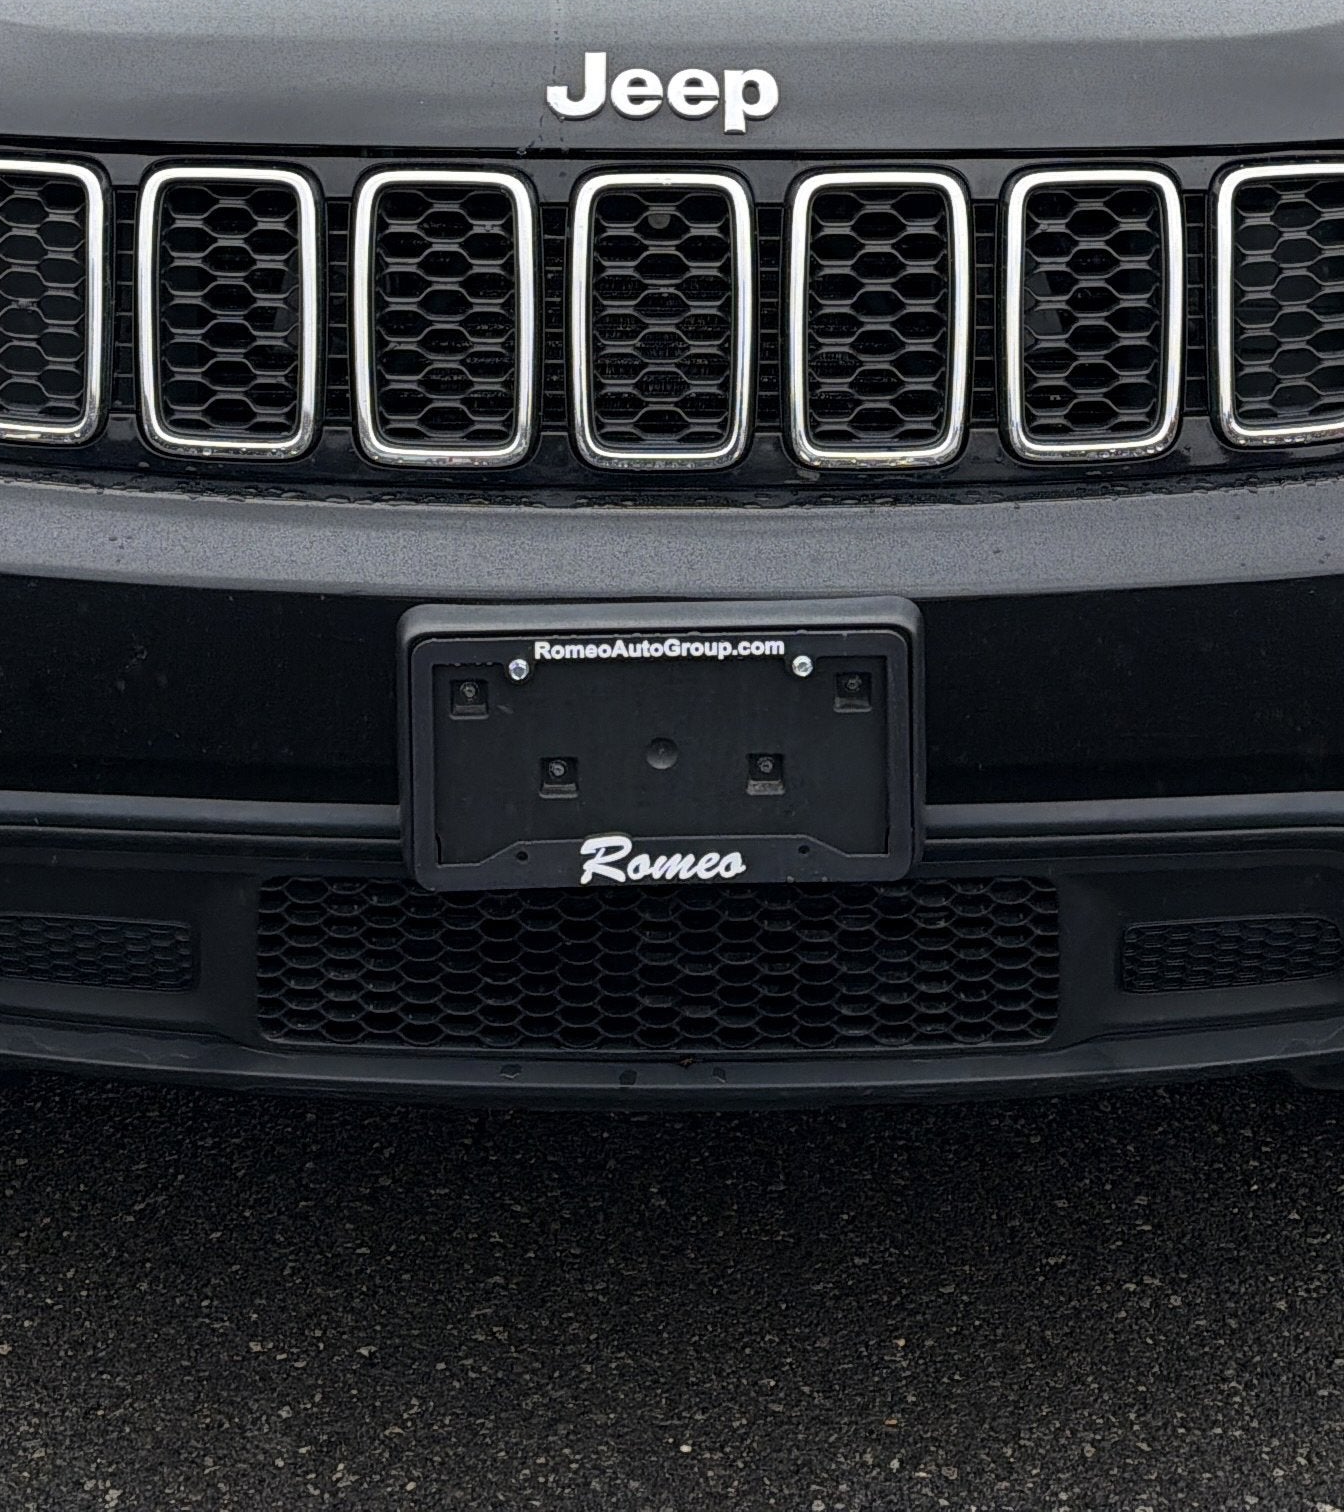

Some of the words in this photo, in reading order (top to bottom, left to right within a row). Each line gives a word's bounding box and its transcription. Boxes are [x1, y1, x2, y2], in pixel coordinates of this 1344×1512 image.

[546, 51, 779, 135] Jeep
[534, 639, 785, 660] RomeoAutoGroup.com
[580, 835, 747, 885] Romeo
